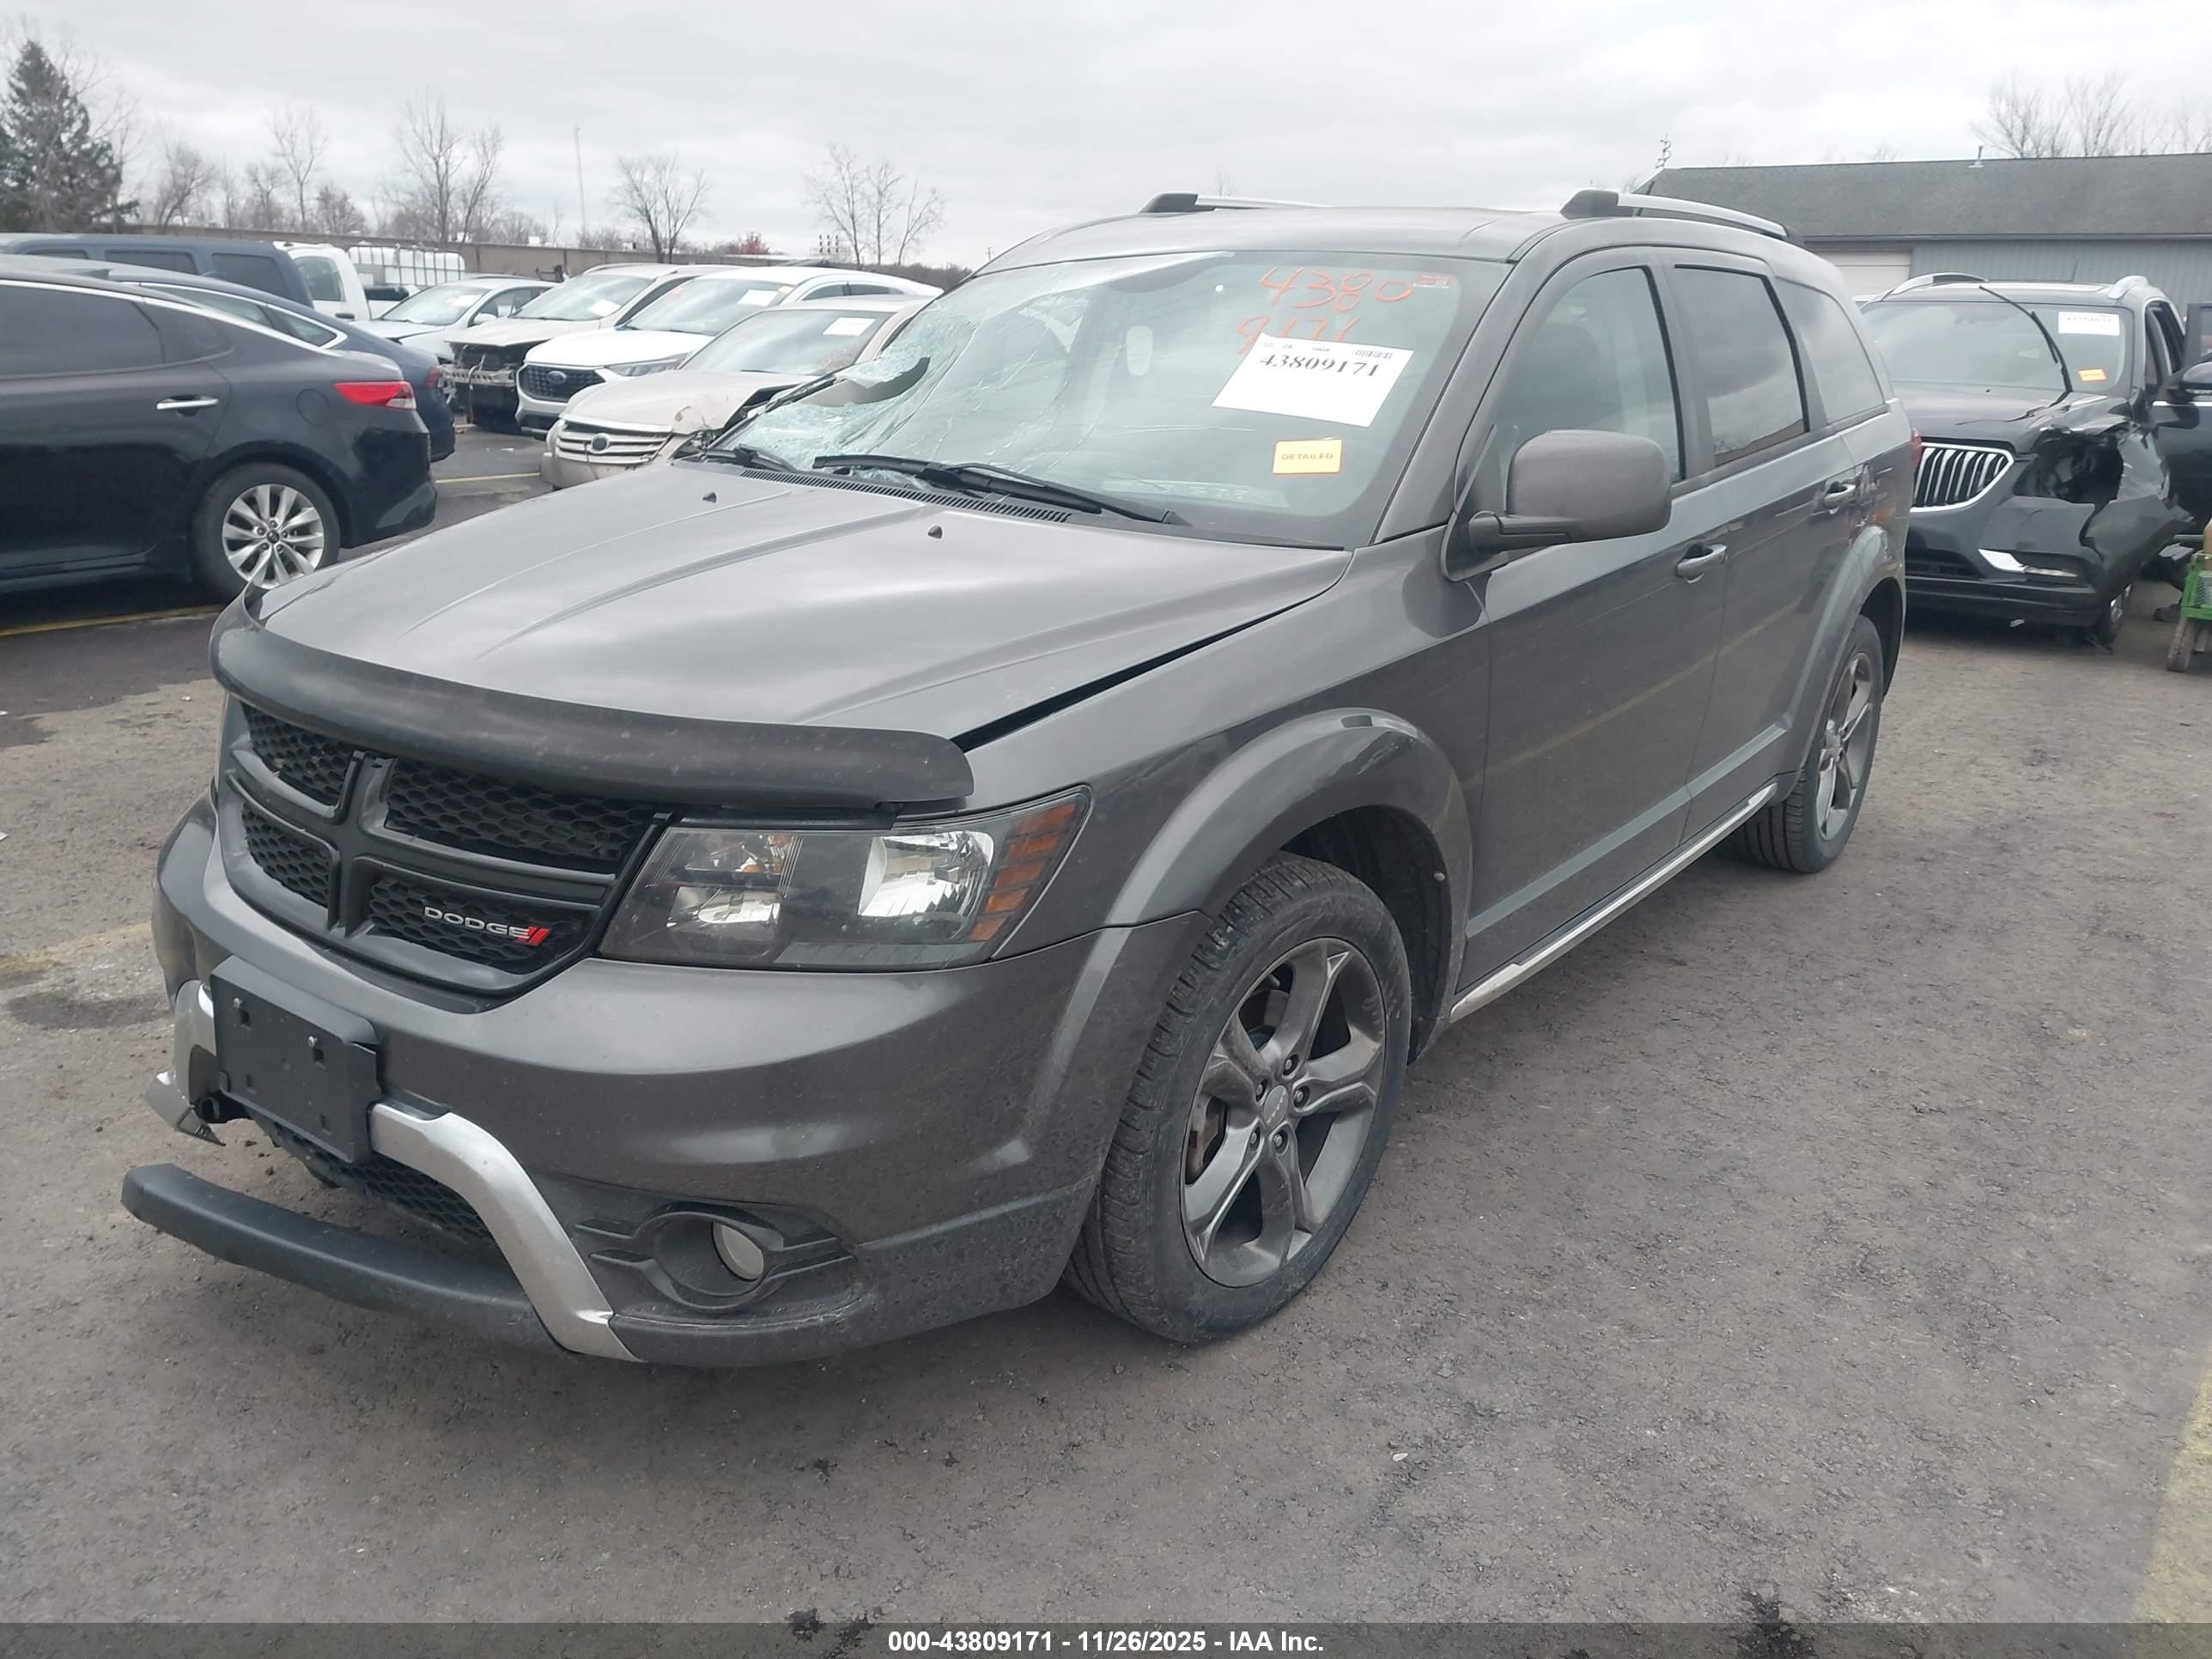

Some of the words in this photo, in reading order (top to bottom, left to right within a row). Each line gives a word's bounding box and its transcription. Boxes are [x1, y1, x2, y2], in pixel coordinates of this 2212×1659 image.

[1259, 266, 1415, 313] 4380
[1260, 353, 1380, 377] 43809171
[423, 906, 531, 940] DODGE
